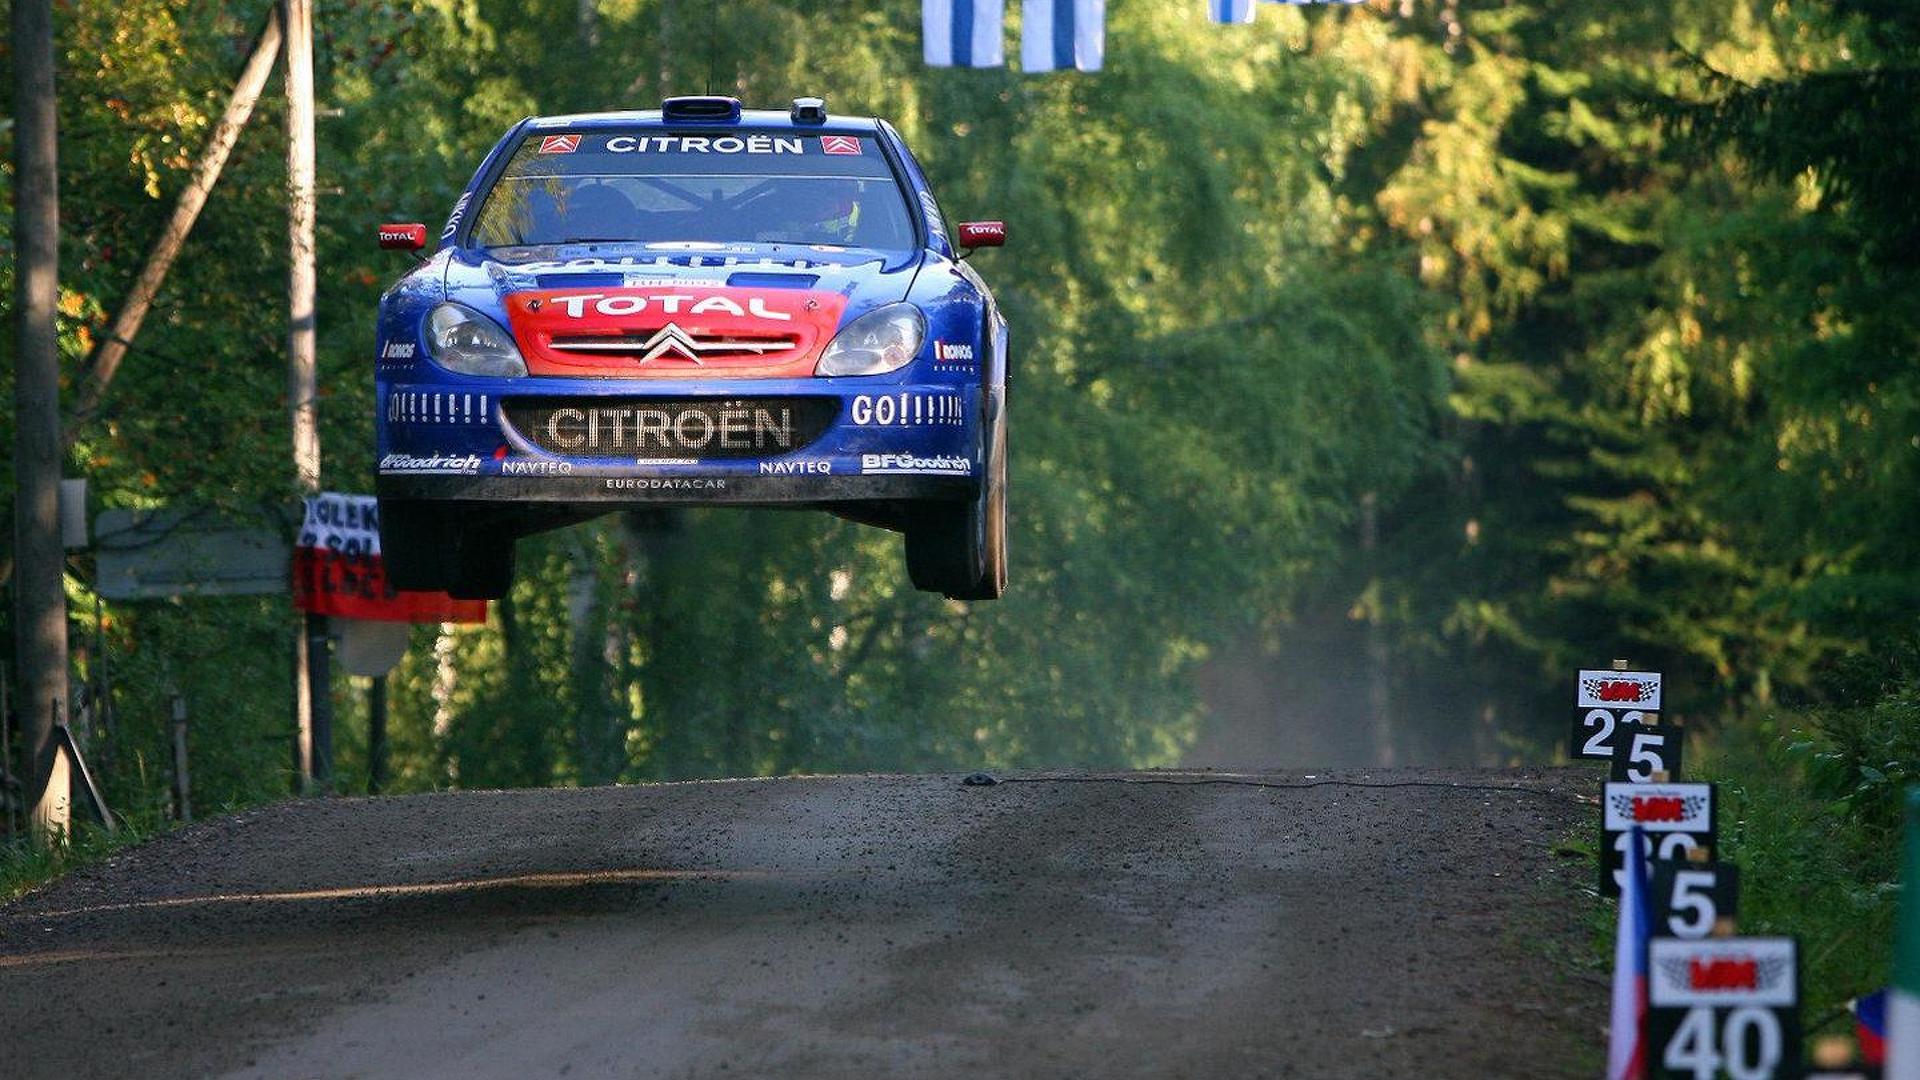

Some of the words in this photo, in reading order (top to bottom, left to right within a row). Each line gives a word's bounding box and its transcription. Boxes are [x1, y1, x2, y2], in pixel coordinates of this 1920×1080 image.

[606, 134, 803, 155] CITROËN
[379, 231, 417, 241] TOTAL
[967, 226, 1005, 235] TOTAL
[551, 294, 791, 321] TOTAL
[547, 400, 791, 449] CITROËN
[502, 461, 572, 475] NAVTEQ
[759, 461, 831, 475] NAVTEQ
[606, 479, 726, 489] EURODATACAR
[1627, 733, 1664, 784] 5
[1667, 871, 1717, 940] 5
[1663, 1004, 1783, 1080] 40
